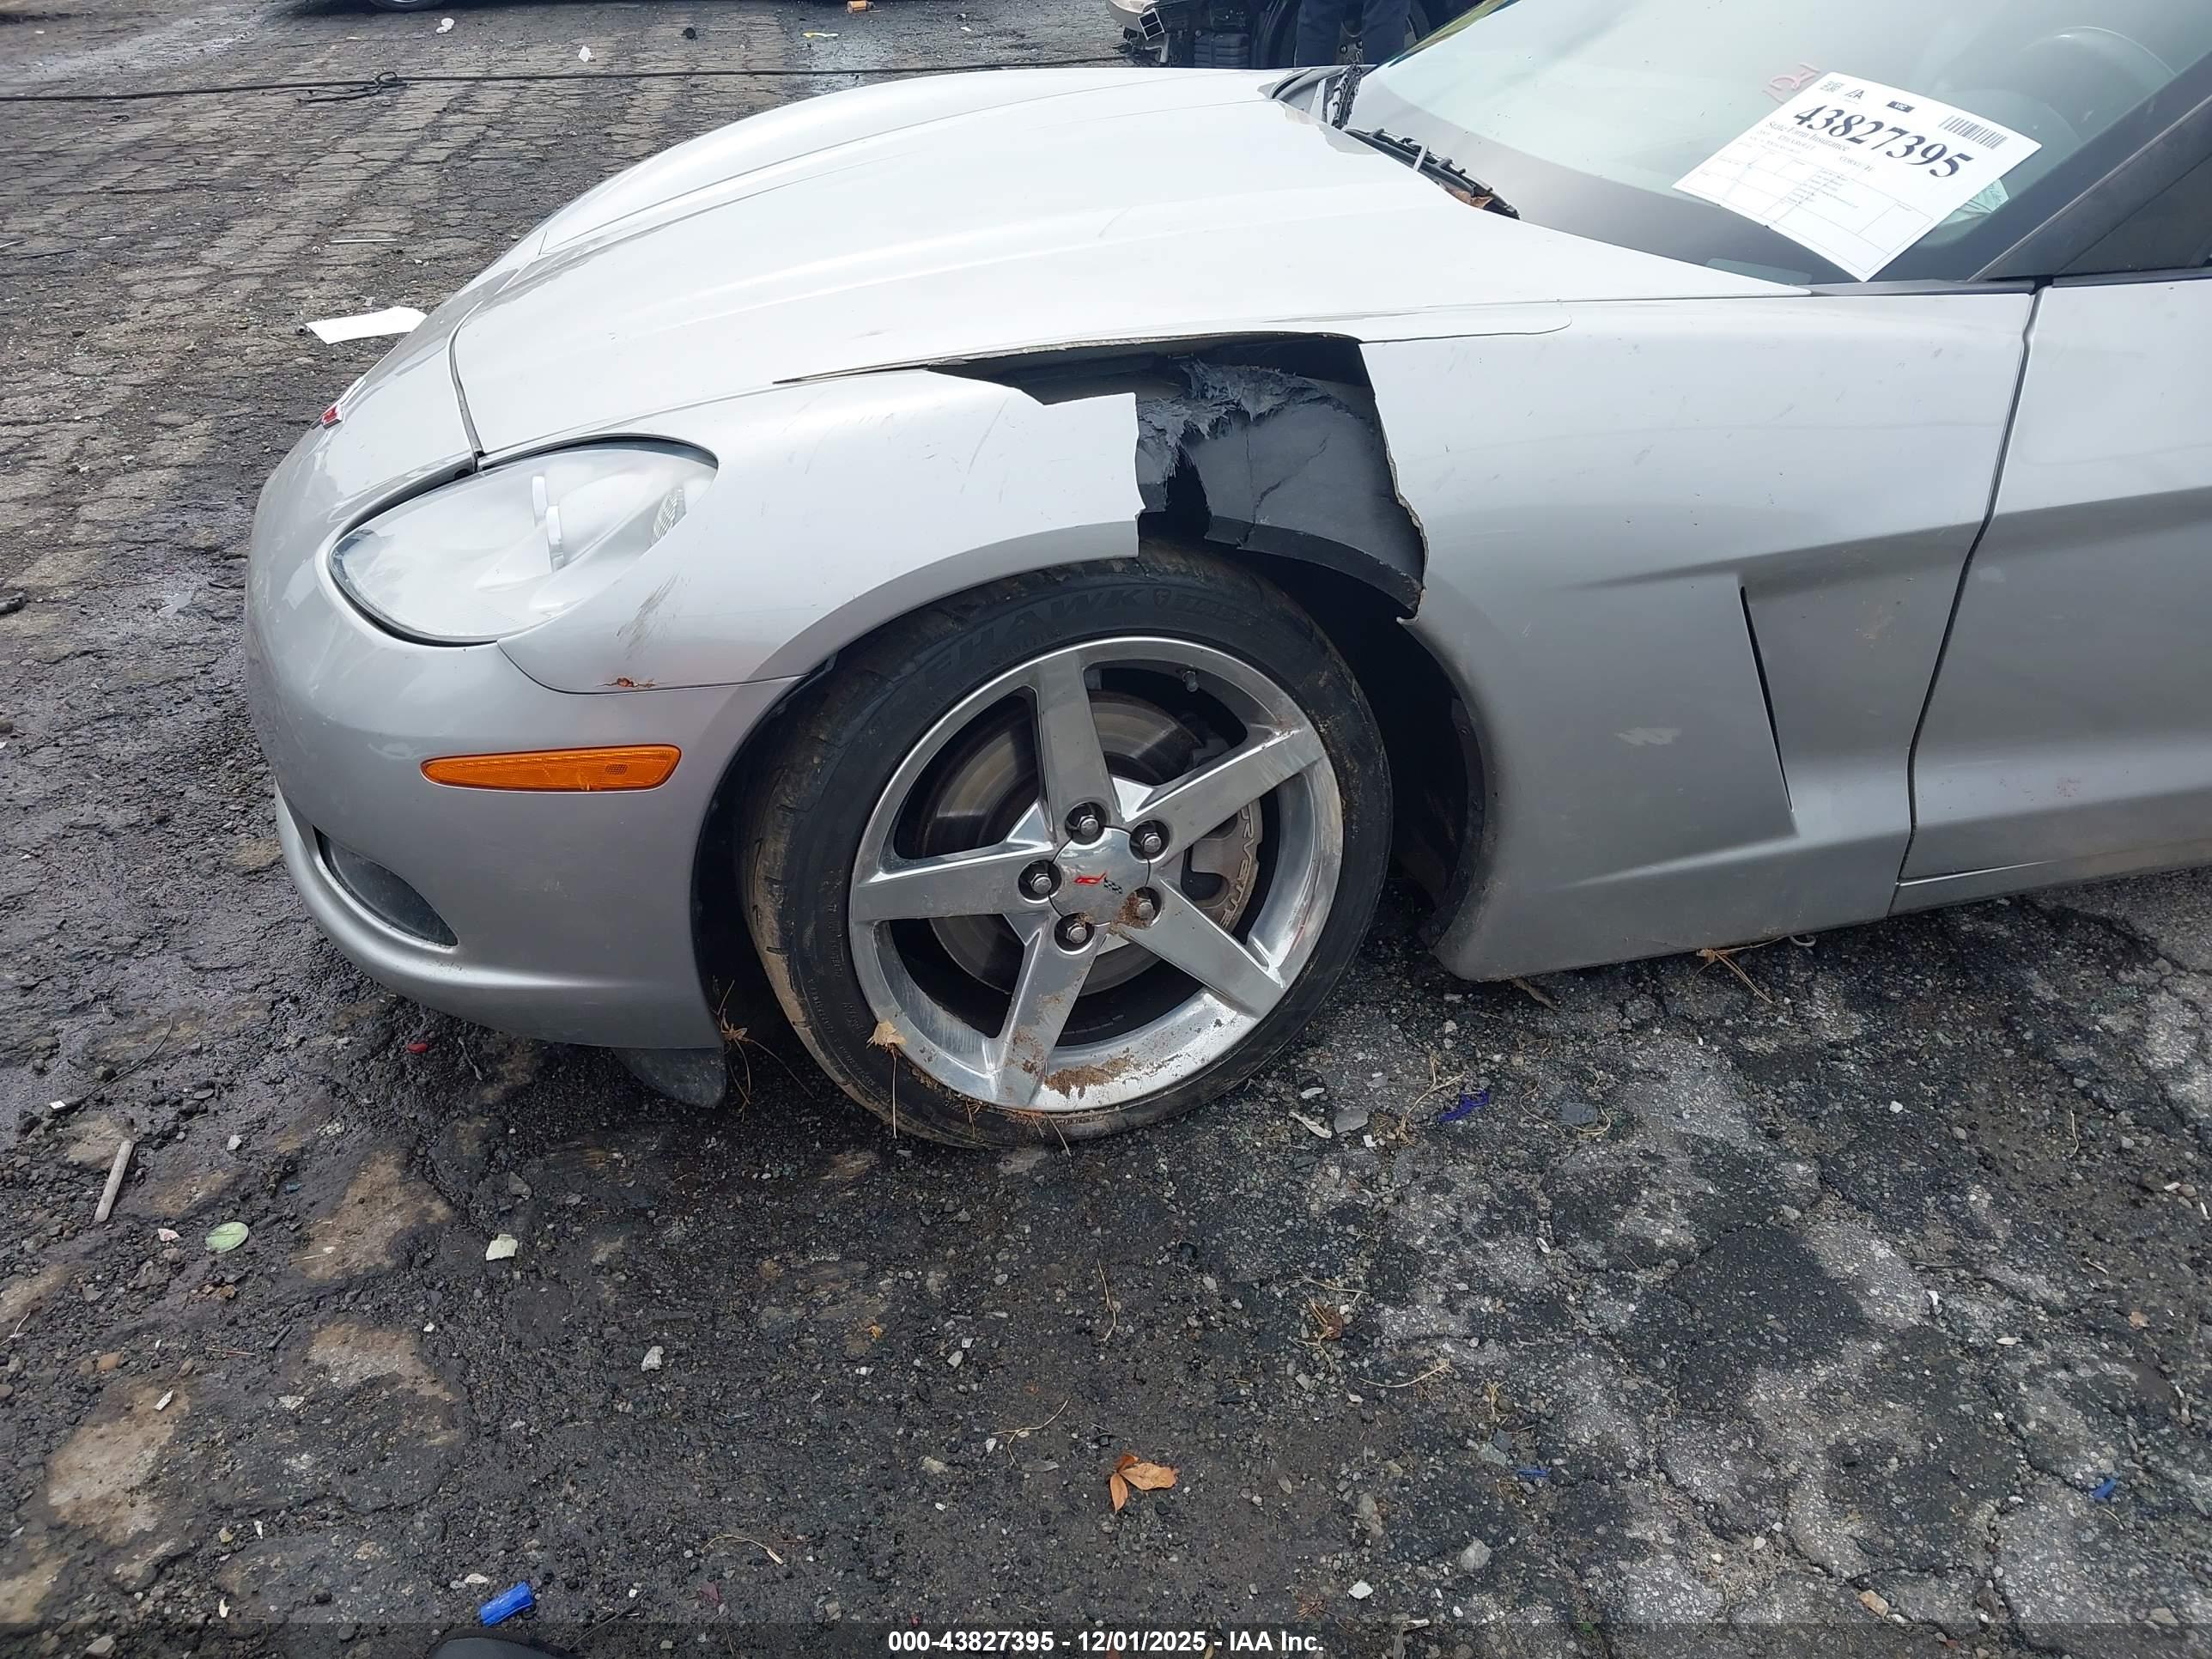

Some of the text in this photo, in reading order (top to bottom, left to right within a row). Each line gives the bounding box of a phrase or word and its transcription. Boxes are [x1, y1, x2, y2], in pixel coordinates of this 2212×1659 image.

[1765, 120, 1787, 132] State
[1787, 126, 1808, 138] Farm
[1809, 133, 1851, 153] Insurance
[1792, 104, 1975, 178] 43827395
